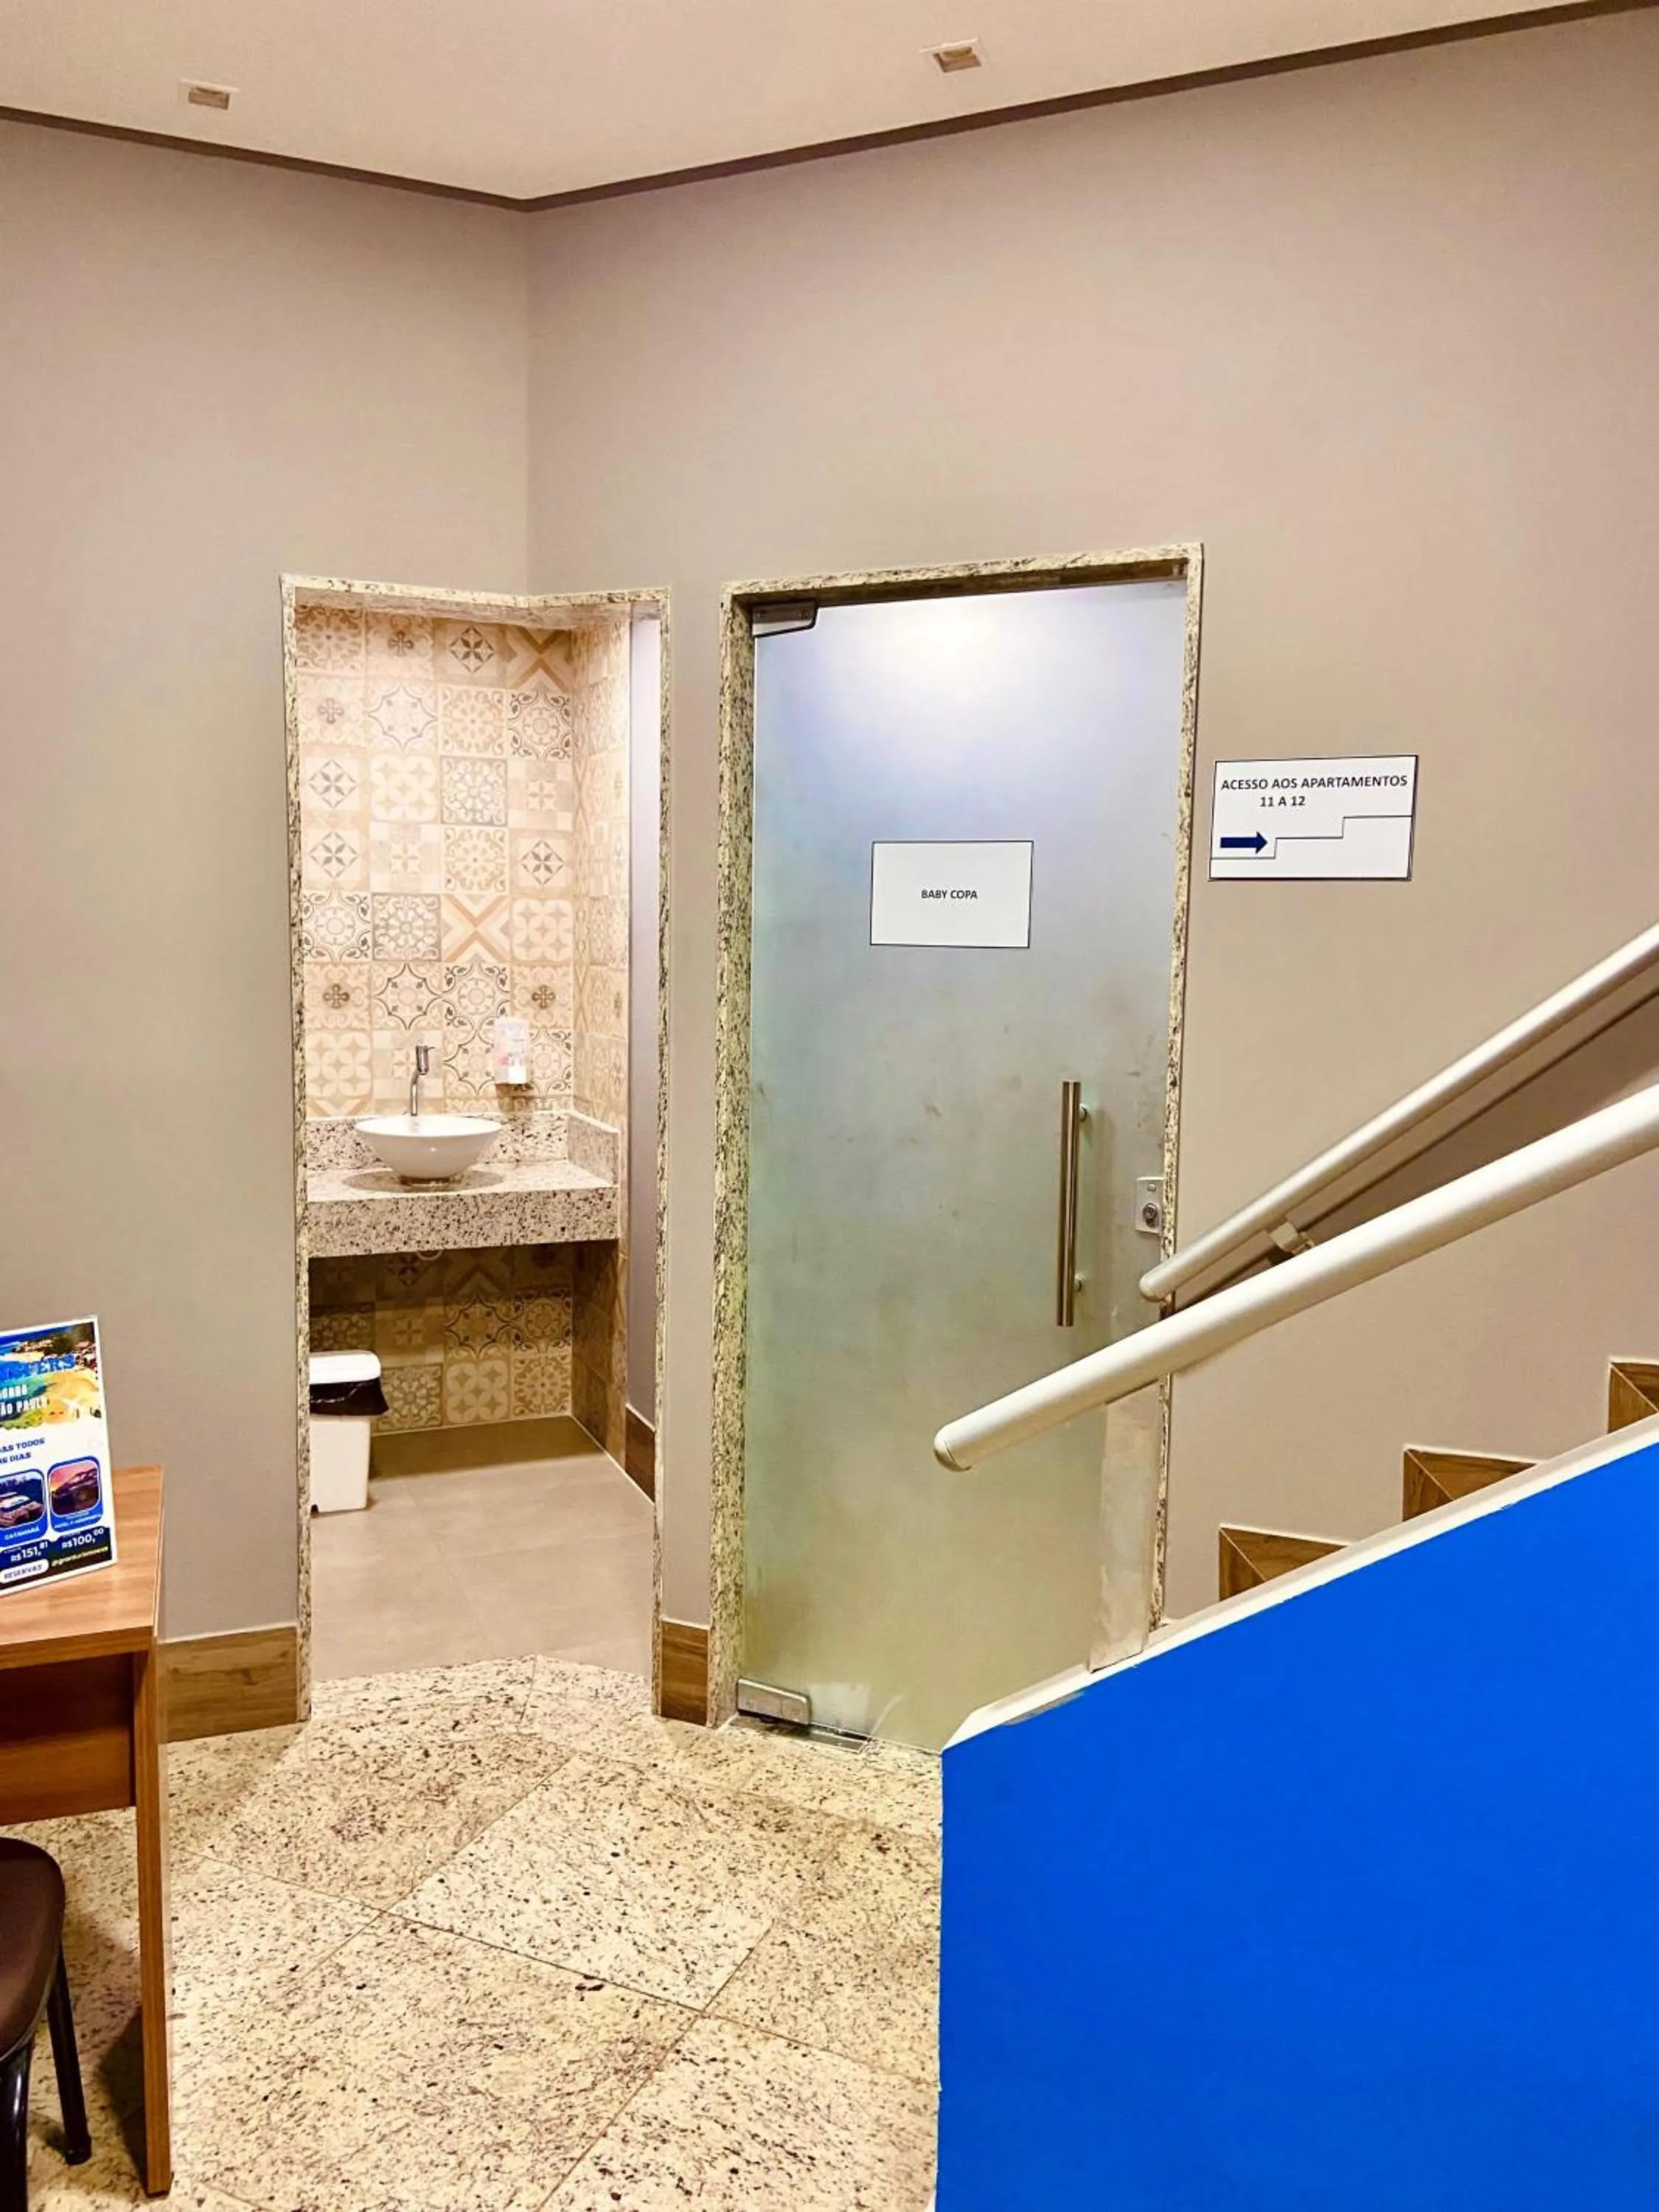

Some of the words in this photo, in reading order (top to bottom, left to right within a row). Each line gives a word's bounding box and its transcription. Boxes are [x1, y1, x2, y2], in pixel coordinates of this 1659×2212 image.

[1221, 779, 1268, 790] ACESSO
[1271, 777, 1298, 789] AOS
[1301, 775, 1408, 789] APARTAMENTOS
[1259, 796, 1274, 807] 11
[1278, 796, 1287, 807] A
[1290, 796, 1306, 807] 12
[921, 889, 947, 900] BABY
[950, 889, 978, 900] COPA
[16, 1437, 45, 1450] TODOS
[10, 1452, 32, 1462] DIAS
